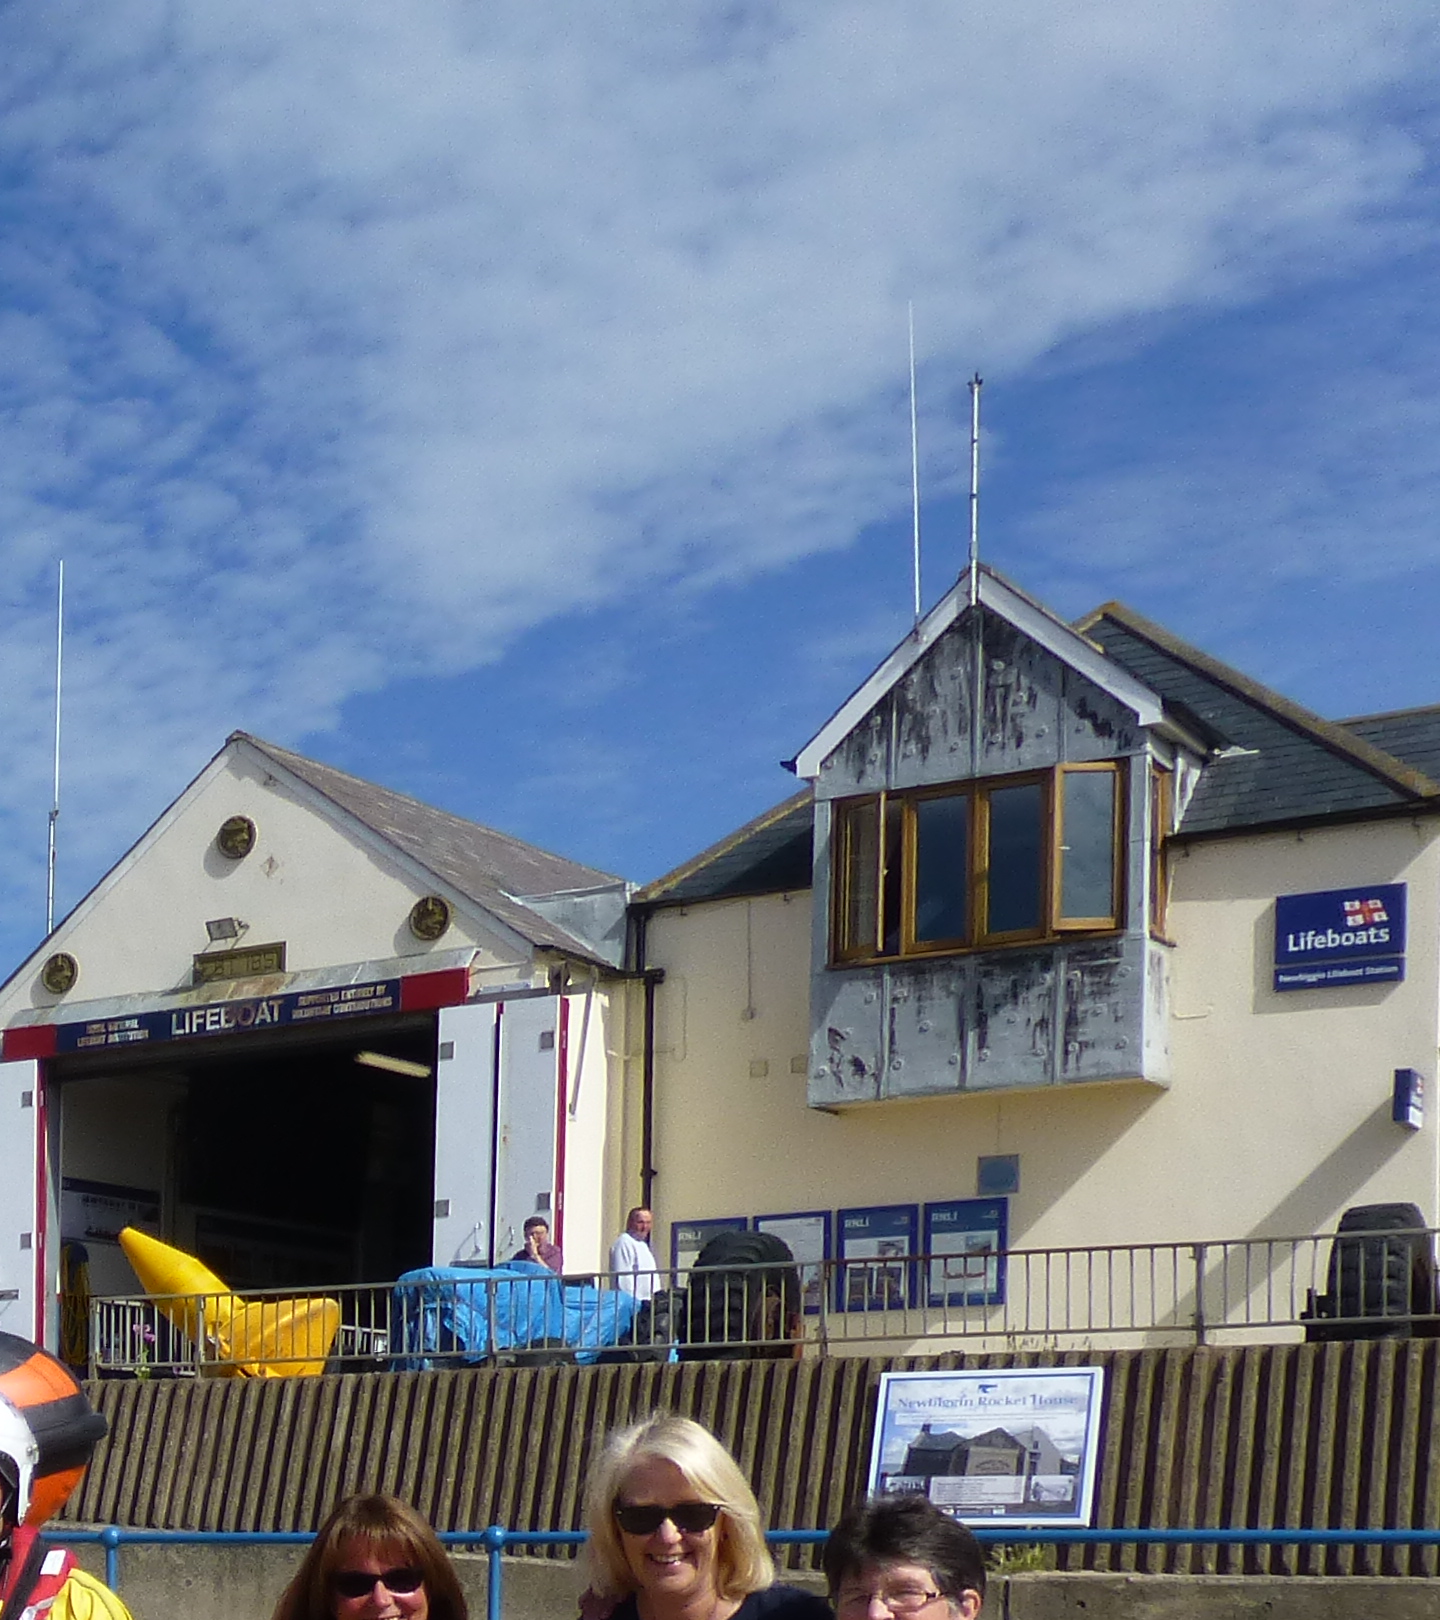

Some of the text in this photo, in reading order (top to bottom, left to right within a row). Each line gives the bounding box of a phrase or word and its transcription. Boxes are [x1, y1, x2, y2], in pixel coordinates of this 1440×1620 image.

[1288, 927, 1390, 952] Lifeboats
[170, 999, 284, 1036] LIFEBOAT
[897, 1393, 1077, 1410] Newbiggin Rocket House
